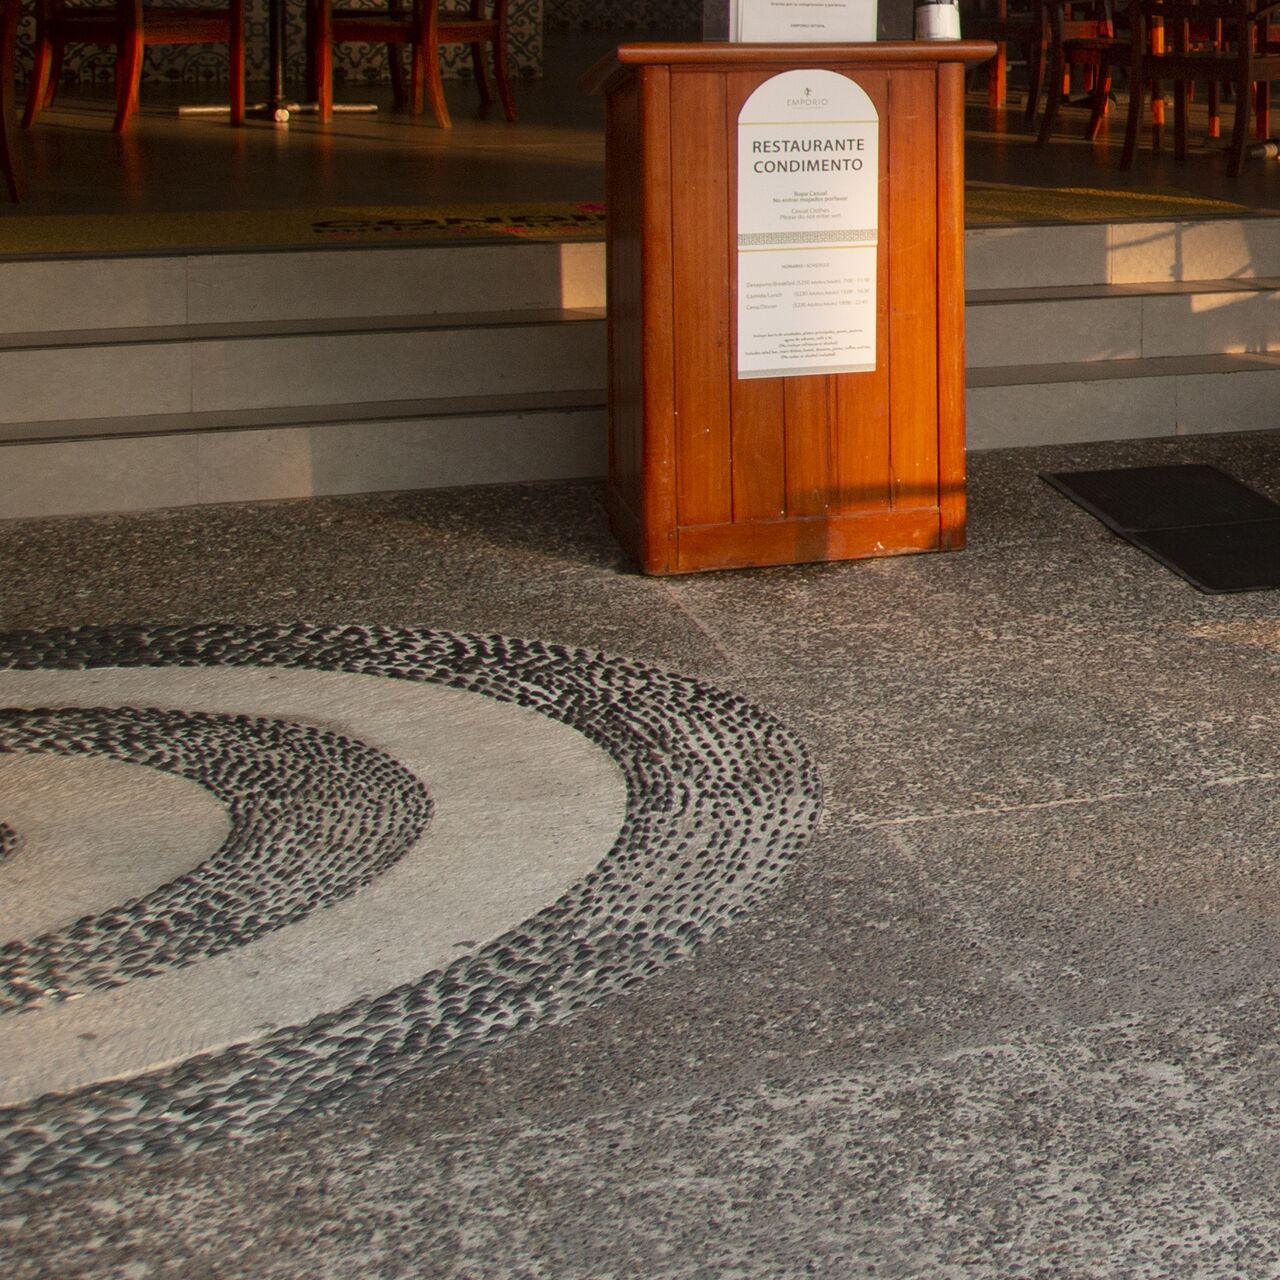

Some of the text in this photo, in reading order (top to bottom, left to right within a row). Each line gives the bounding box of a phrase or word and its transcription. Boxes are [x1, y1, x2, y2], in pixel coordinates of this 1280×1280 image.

[787, 98, 828, 107] EMPORIO
[752, 138, 865, 153] RESTAURANTE
[753, 158, 863, 173] CONDIMENTO
